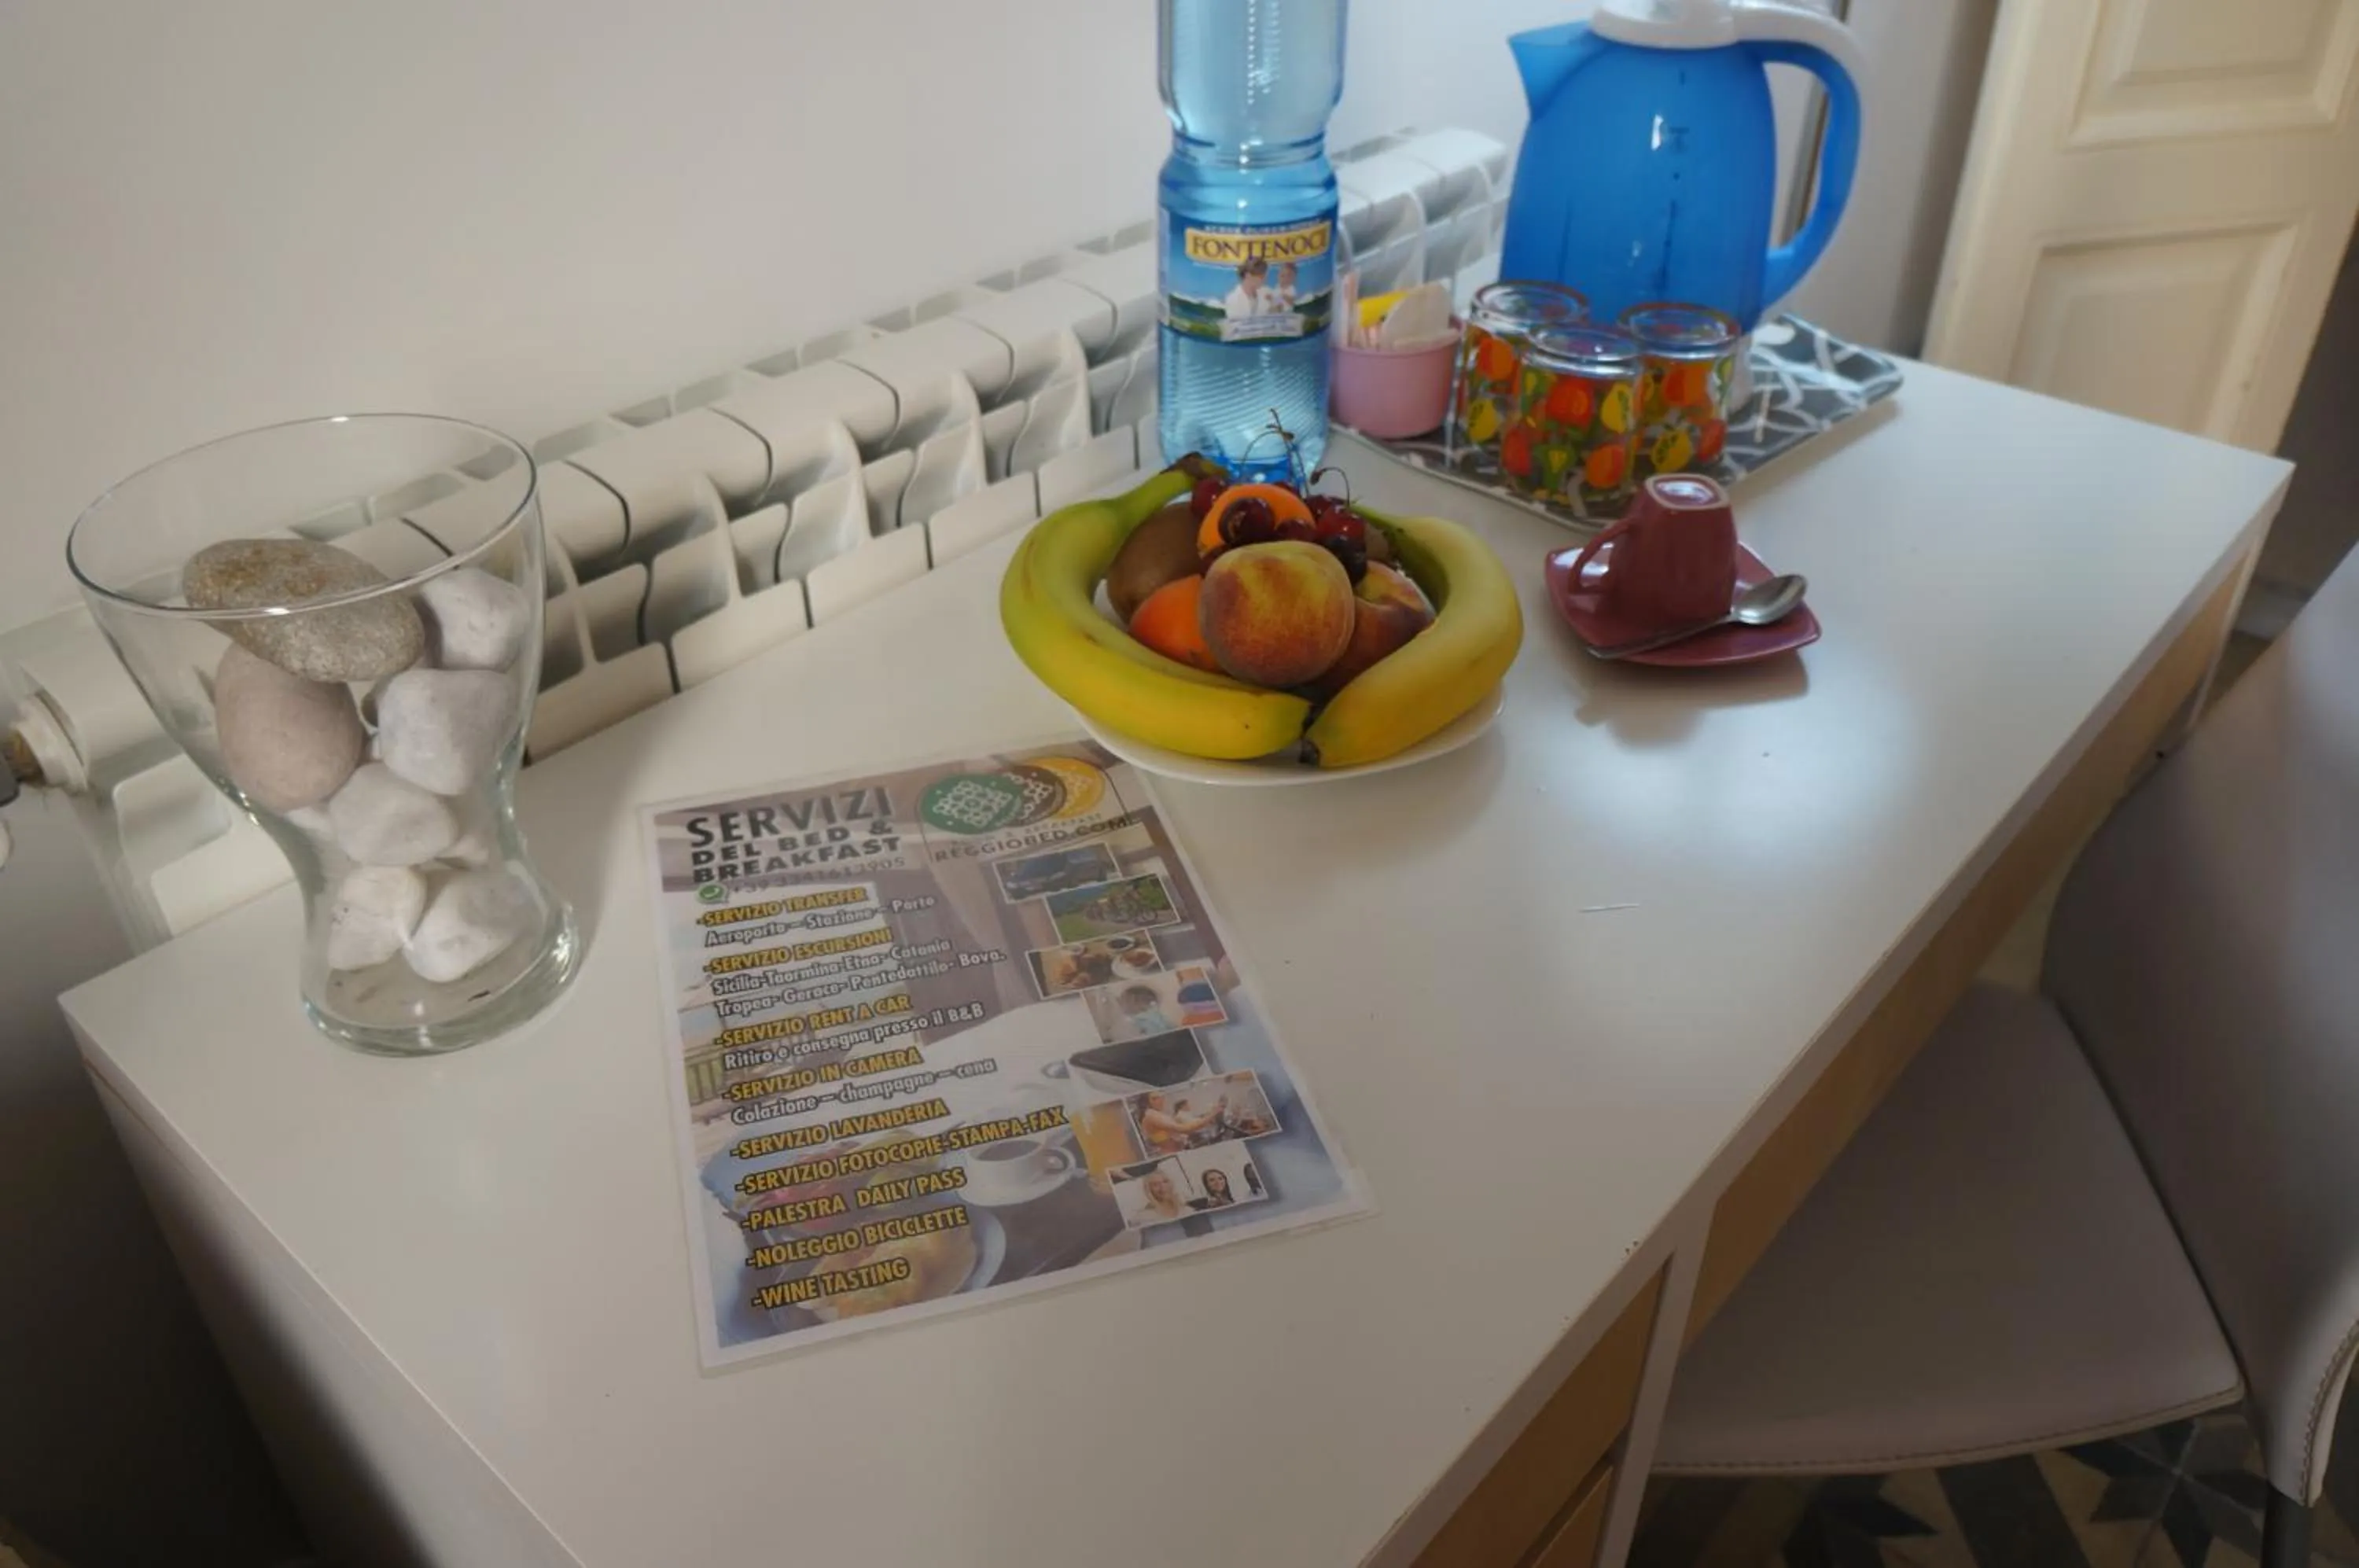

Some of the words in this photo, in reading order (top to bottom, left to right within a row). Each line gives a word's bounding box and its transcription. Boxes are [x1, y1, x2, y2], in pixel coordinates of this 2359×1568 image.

[686, 787, 892, 848] SERVIZI
[691, 843, 761, 865] DEL
[778, 826, 850, 852] BED
[869, 819, 892, 835] &
[693, 837, 900, 883] BREAKFAST
[705, 922, 787, 947] Aeroporto
[805, 907, 874, 929] Stazione
[891, 896, 935, 914] Porto
[783, 887, 867, 911] TRANSFER
[793, 926, 892, 960] ESCURSIONI
[890, 939, 951, 960] Catania
[957, 948, 1007, 968] Bova.
[808, 1005, 855, 1029] RENT
[858, 1003, 874, 1021] A
[874, 995, 912, 1014] CAR
[723, 1050, 775, 1070] Ritiro
[777, 1045, 789, 1058] e
[791, 1029, 870, 1055] consegna
[874, 1016, 929, 1043] presso
[930, 1008, 944, 1026] il
[947, 1001, 984, 1022] B&B
[819, 1063, 843, 1083] IN
[845, 1046, 924, 1077] CAMERA
[731, 1097, 819, 1125] Colazione
[838, 1071, 936, 1104] champagne
[955, 1058, 998, 1079] cena
[730, 1125, 828, 1159] -SERVIZIO
[830, 1098, 950, 1138] LAVANDERIA
[735, 1159, 836, 1194] -SERVIZIO
[741, 1194, 848, 1231] -PALESTRA
[856, 1179, 912, 1209] DAILY
[916, 1166, 967, 1195] PASS
[746, 1229, 862, 1268] -NOLEGGIO
[863, 1205, 969, 1246] BICICLETTE
[752, 1273, 819, 1309] -WINE
[821, 1257, 911, 1295] TASTING
